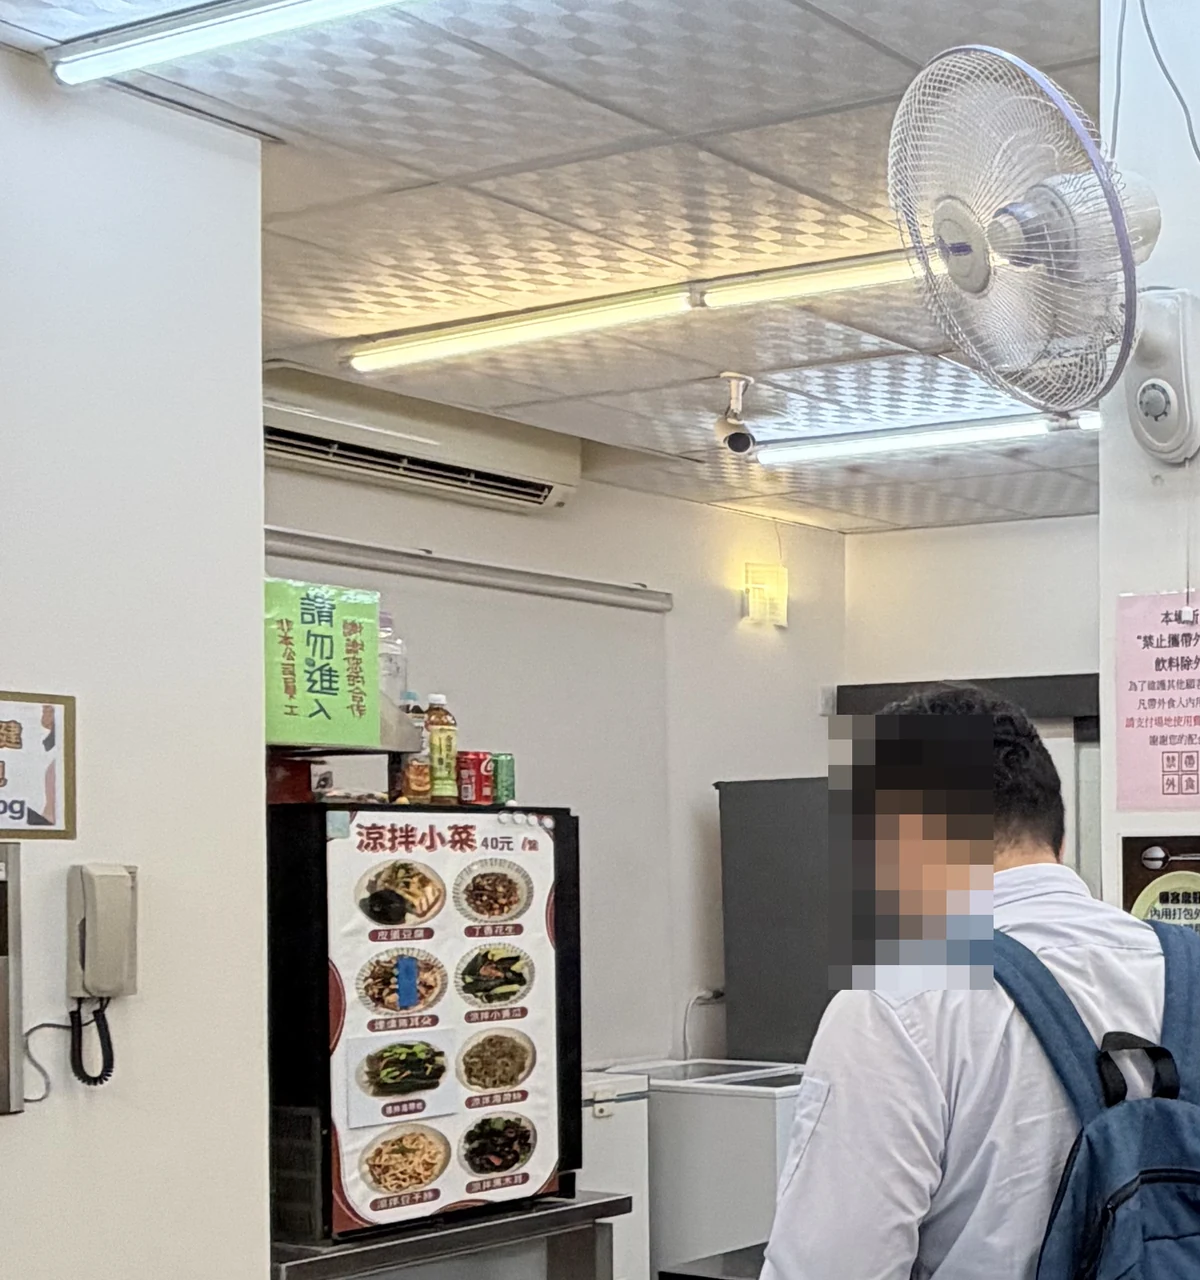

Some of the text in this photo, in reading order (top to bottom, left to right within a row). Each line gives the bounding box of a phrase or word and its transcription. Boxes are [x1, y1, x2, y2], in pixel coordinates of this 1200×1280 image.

[300, 590, 340, 720] 請勿進入
[356, 823, 477, 853] 涼拌小菜
